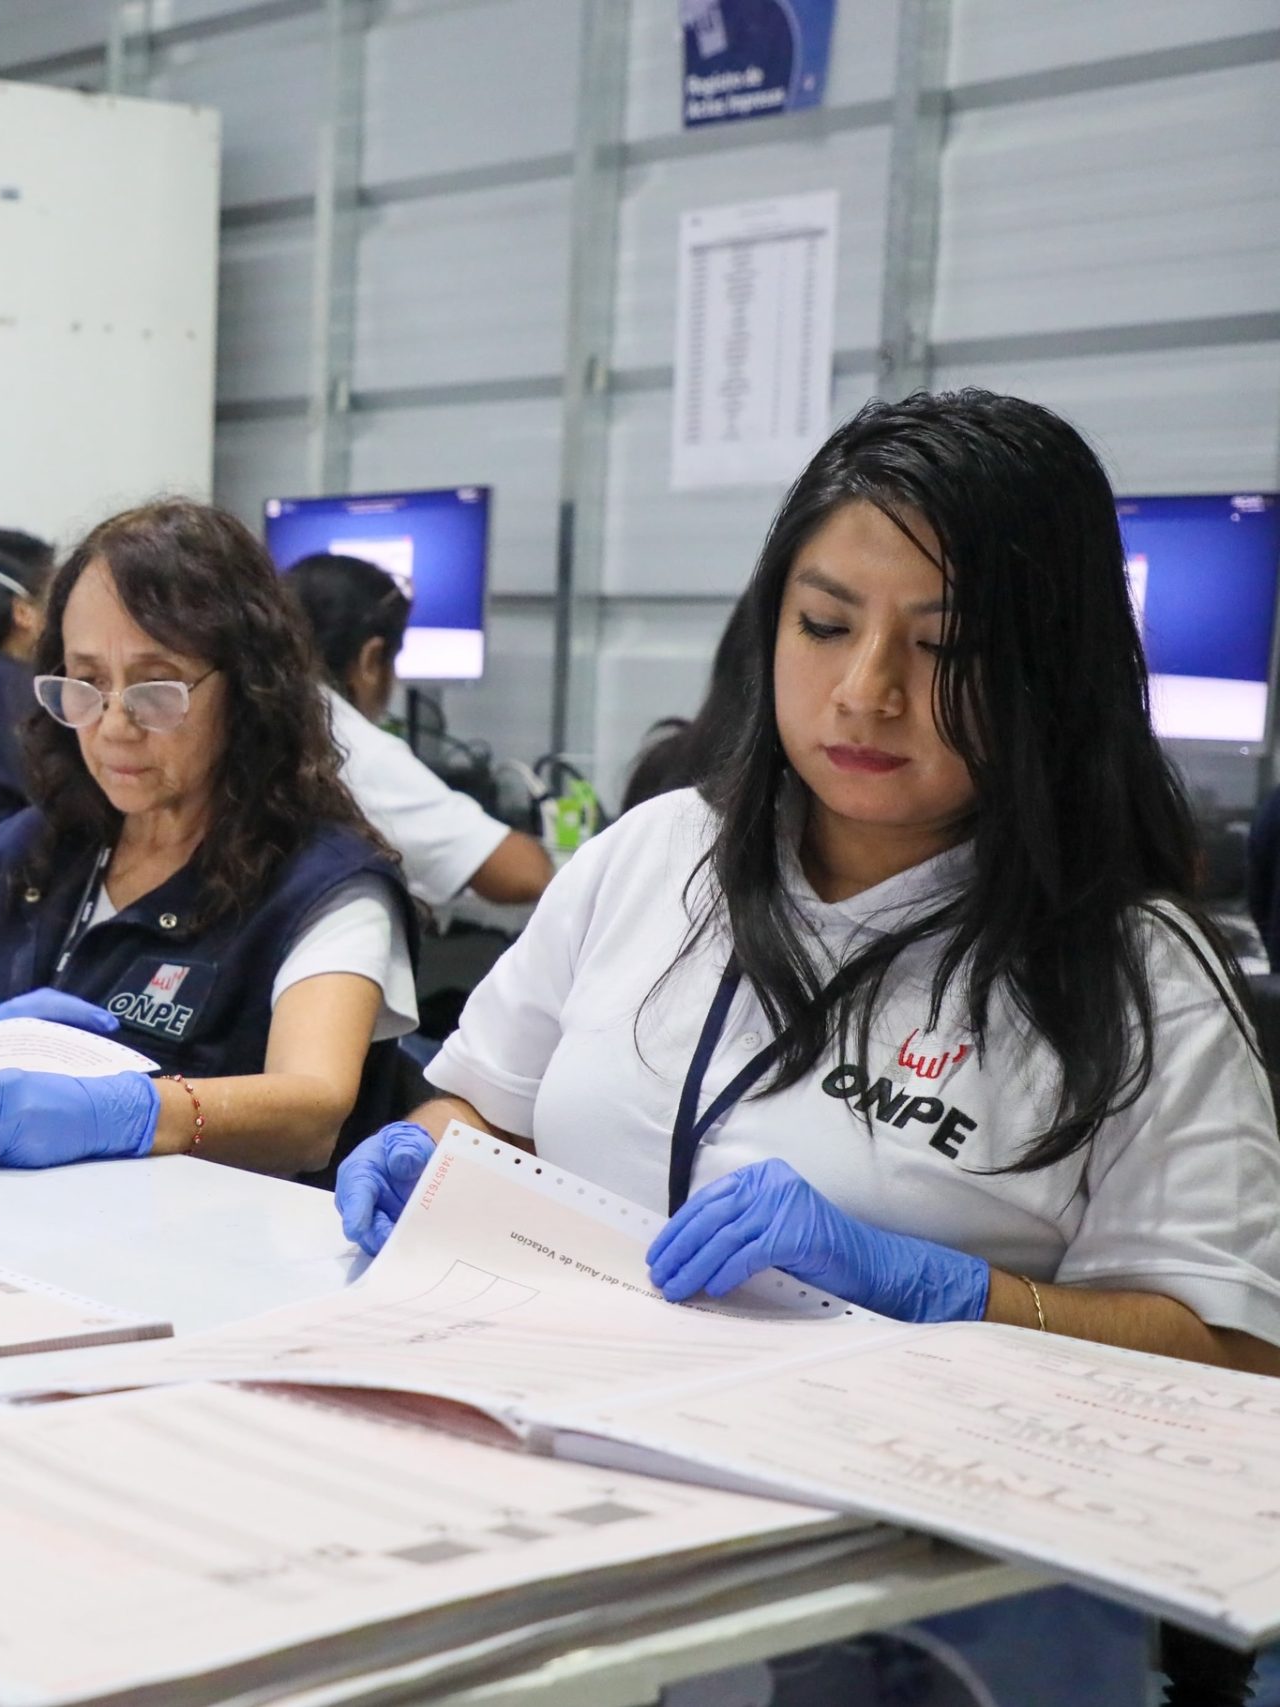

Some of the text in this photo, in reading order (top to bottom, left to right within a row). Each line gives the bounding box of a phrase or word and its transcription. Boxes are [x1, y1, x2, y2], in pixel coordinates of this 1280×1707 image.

[108, 993, 193, 1035] ONPE
[822, 1064, 977, 1160] ONPE
[420, 1154, 453, 1211] 348576137
[558, 1254, 573, 1266] de
[575, 1262, 601, 1278] Aula
[602, 1274, 620, 1286] del
[622, 1281, 663, 1301] entrada
